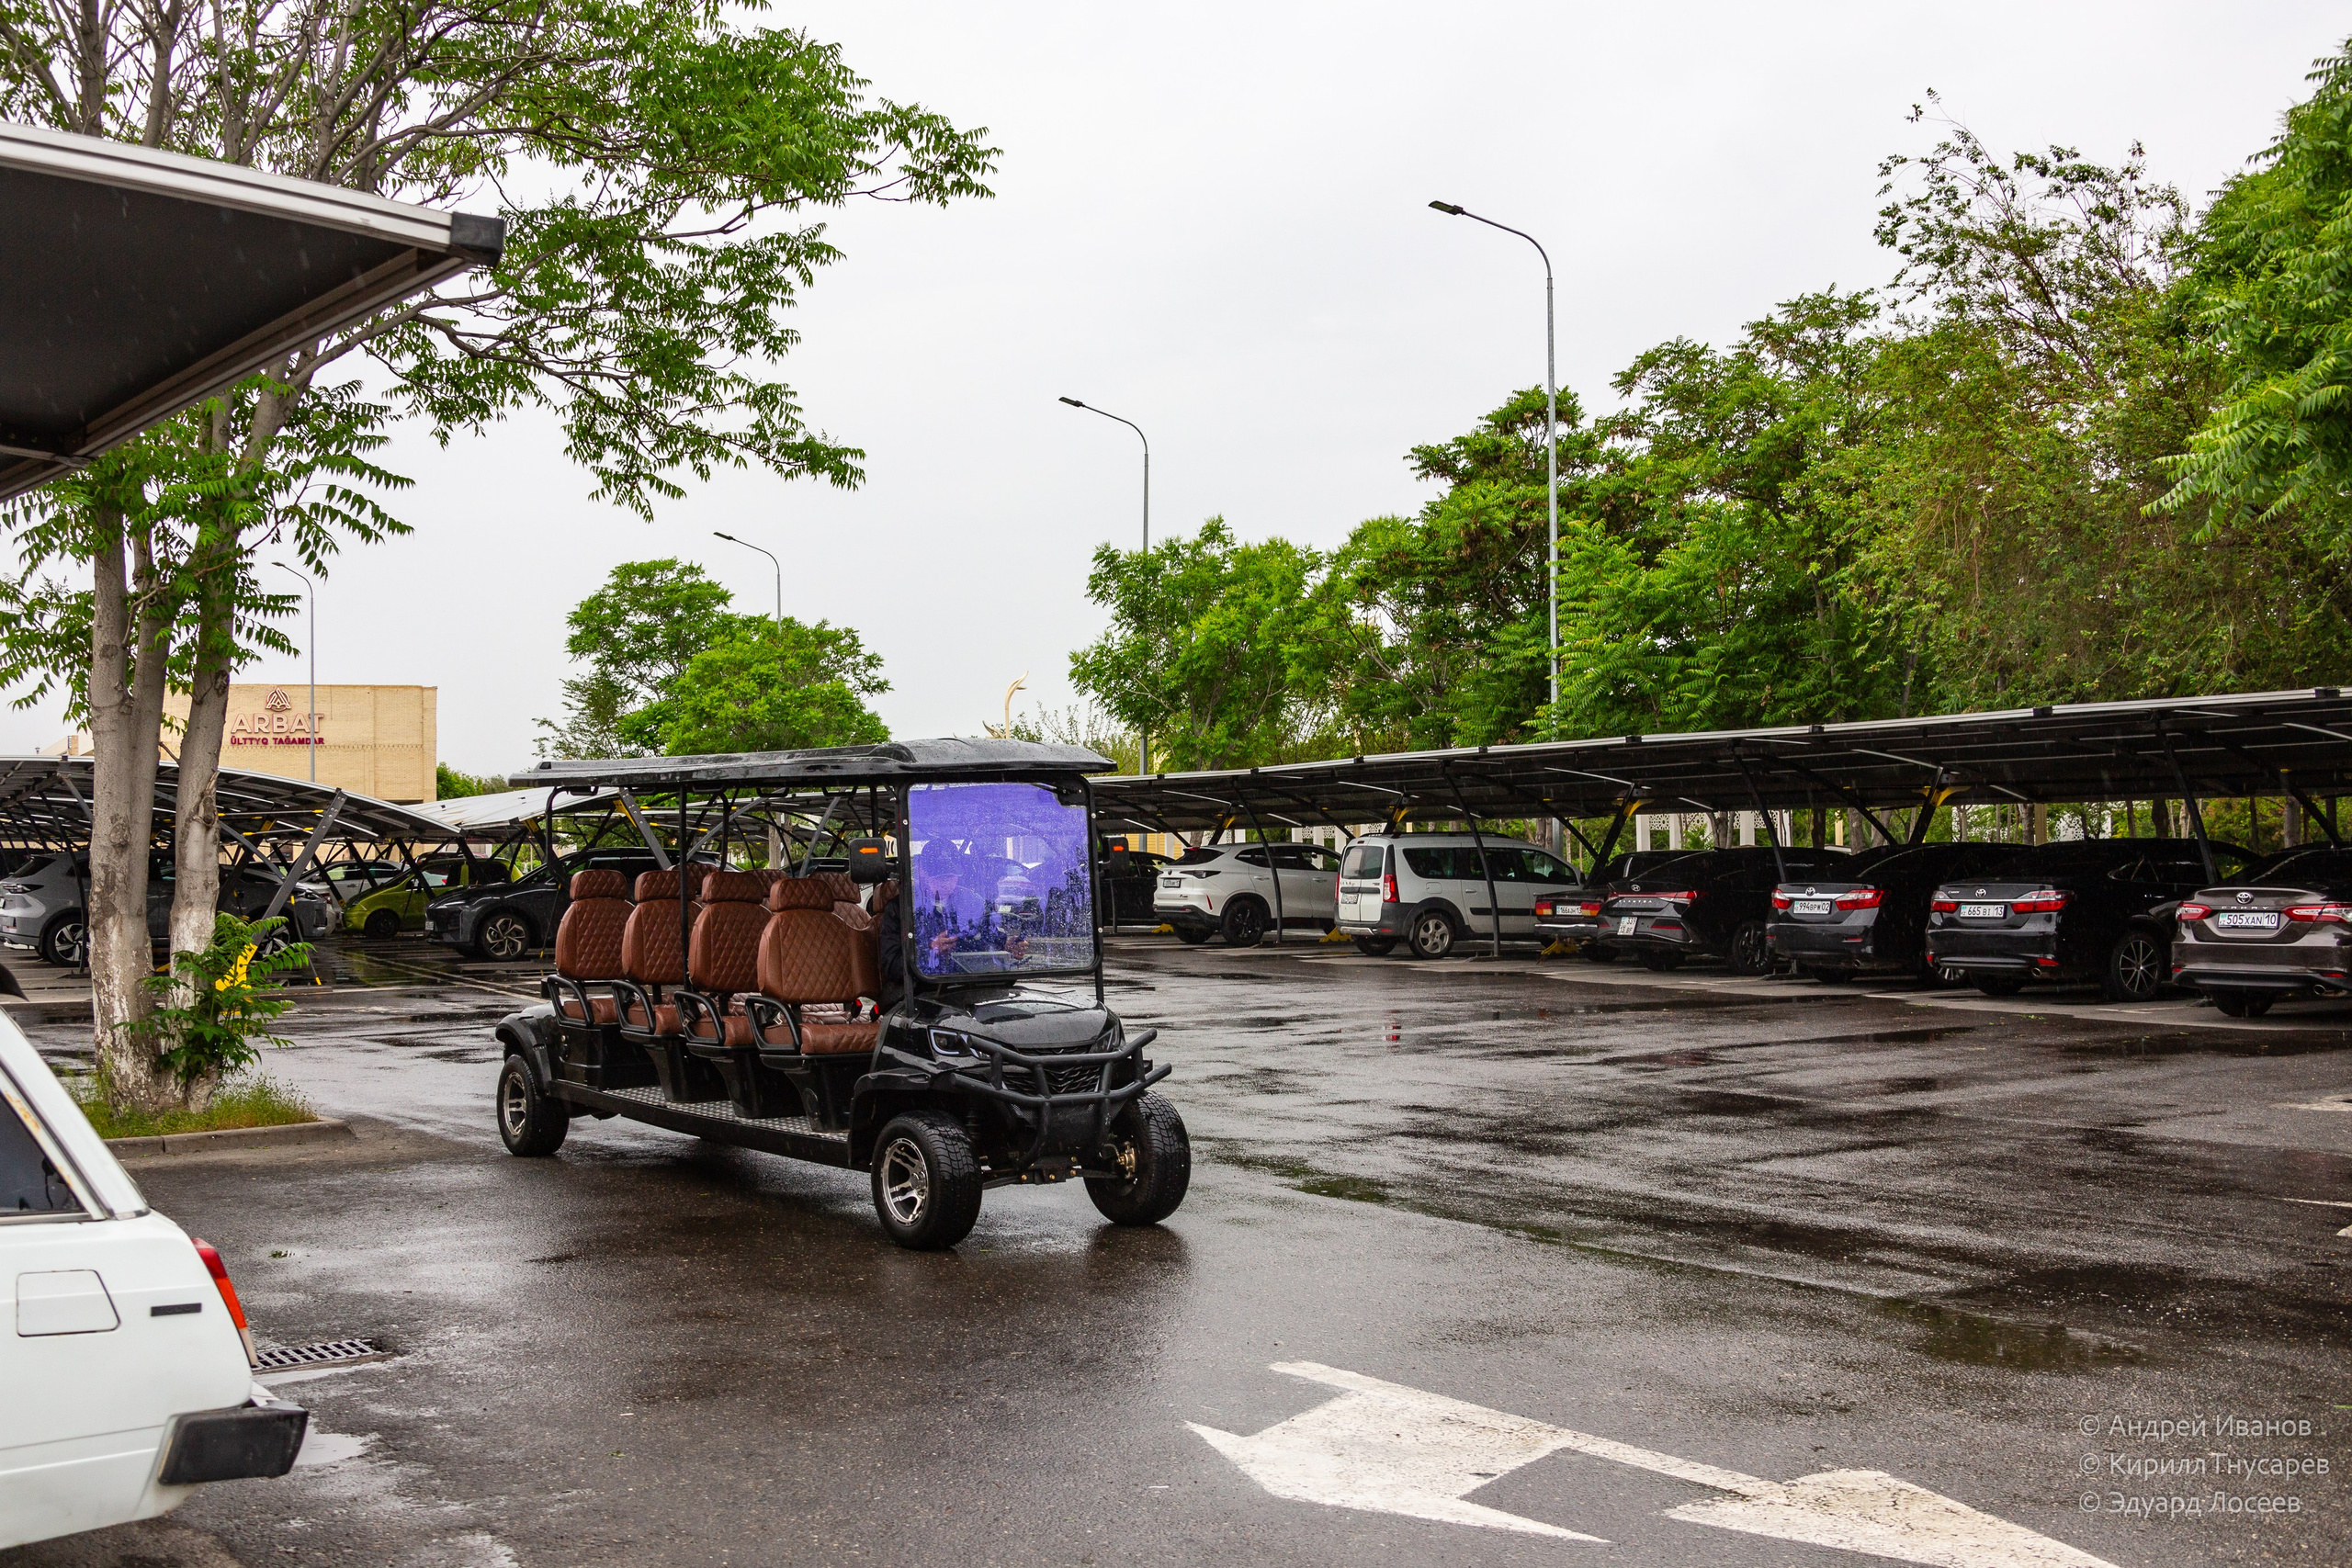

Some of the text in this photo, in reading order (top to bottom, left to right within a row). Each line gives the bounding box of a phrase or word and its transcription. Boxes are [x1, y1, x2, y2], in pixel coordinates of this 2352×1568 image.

[231, 713, 324, 734] ARBAT
[1994, 906, 2004, 916] 13
[2265, 914, 2277, 925] 10
